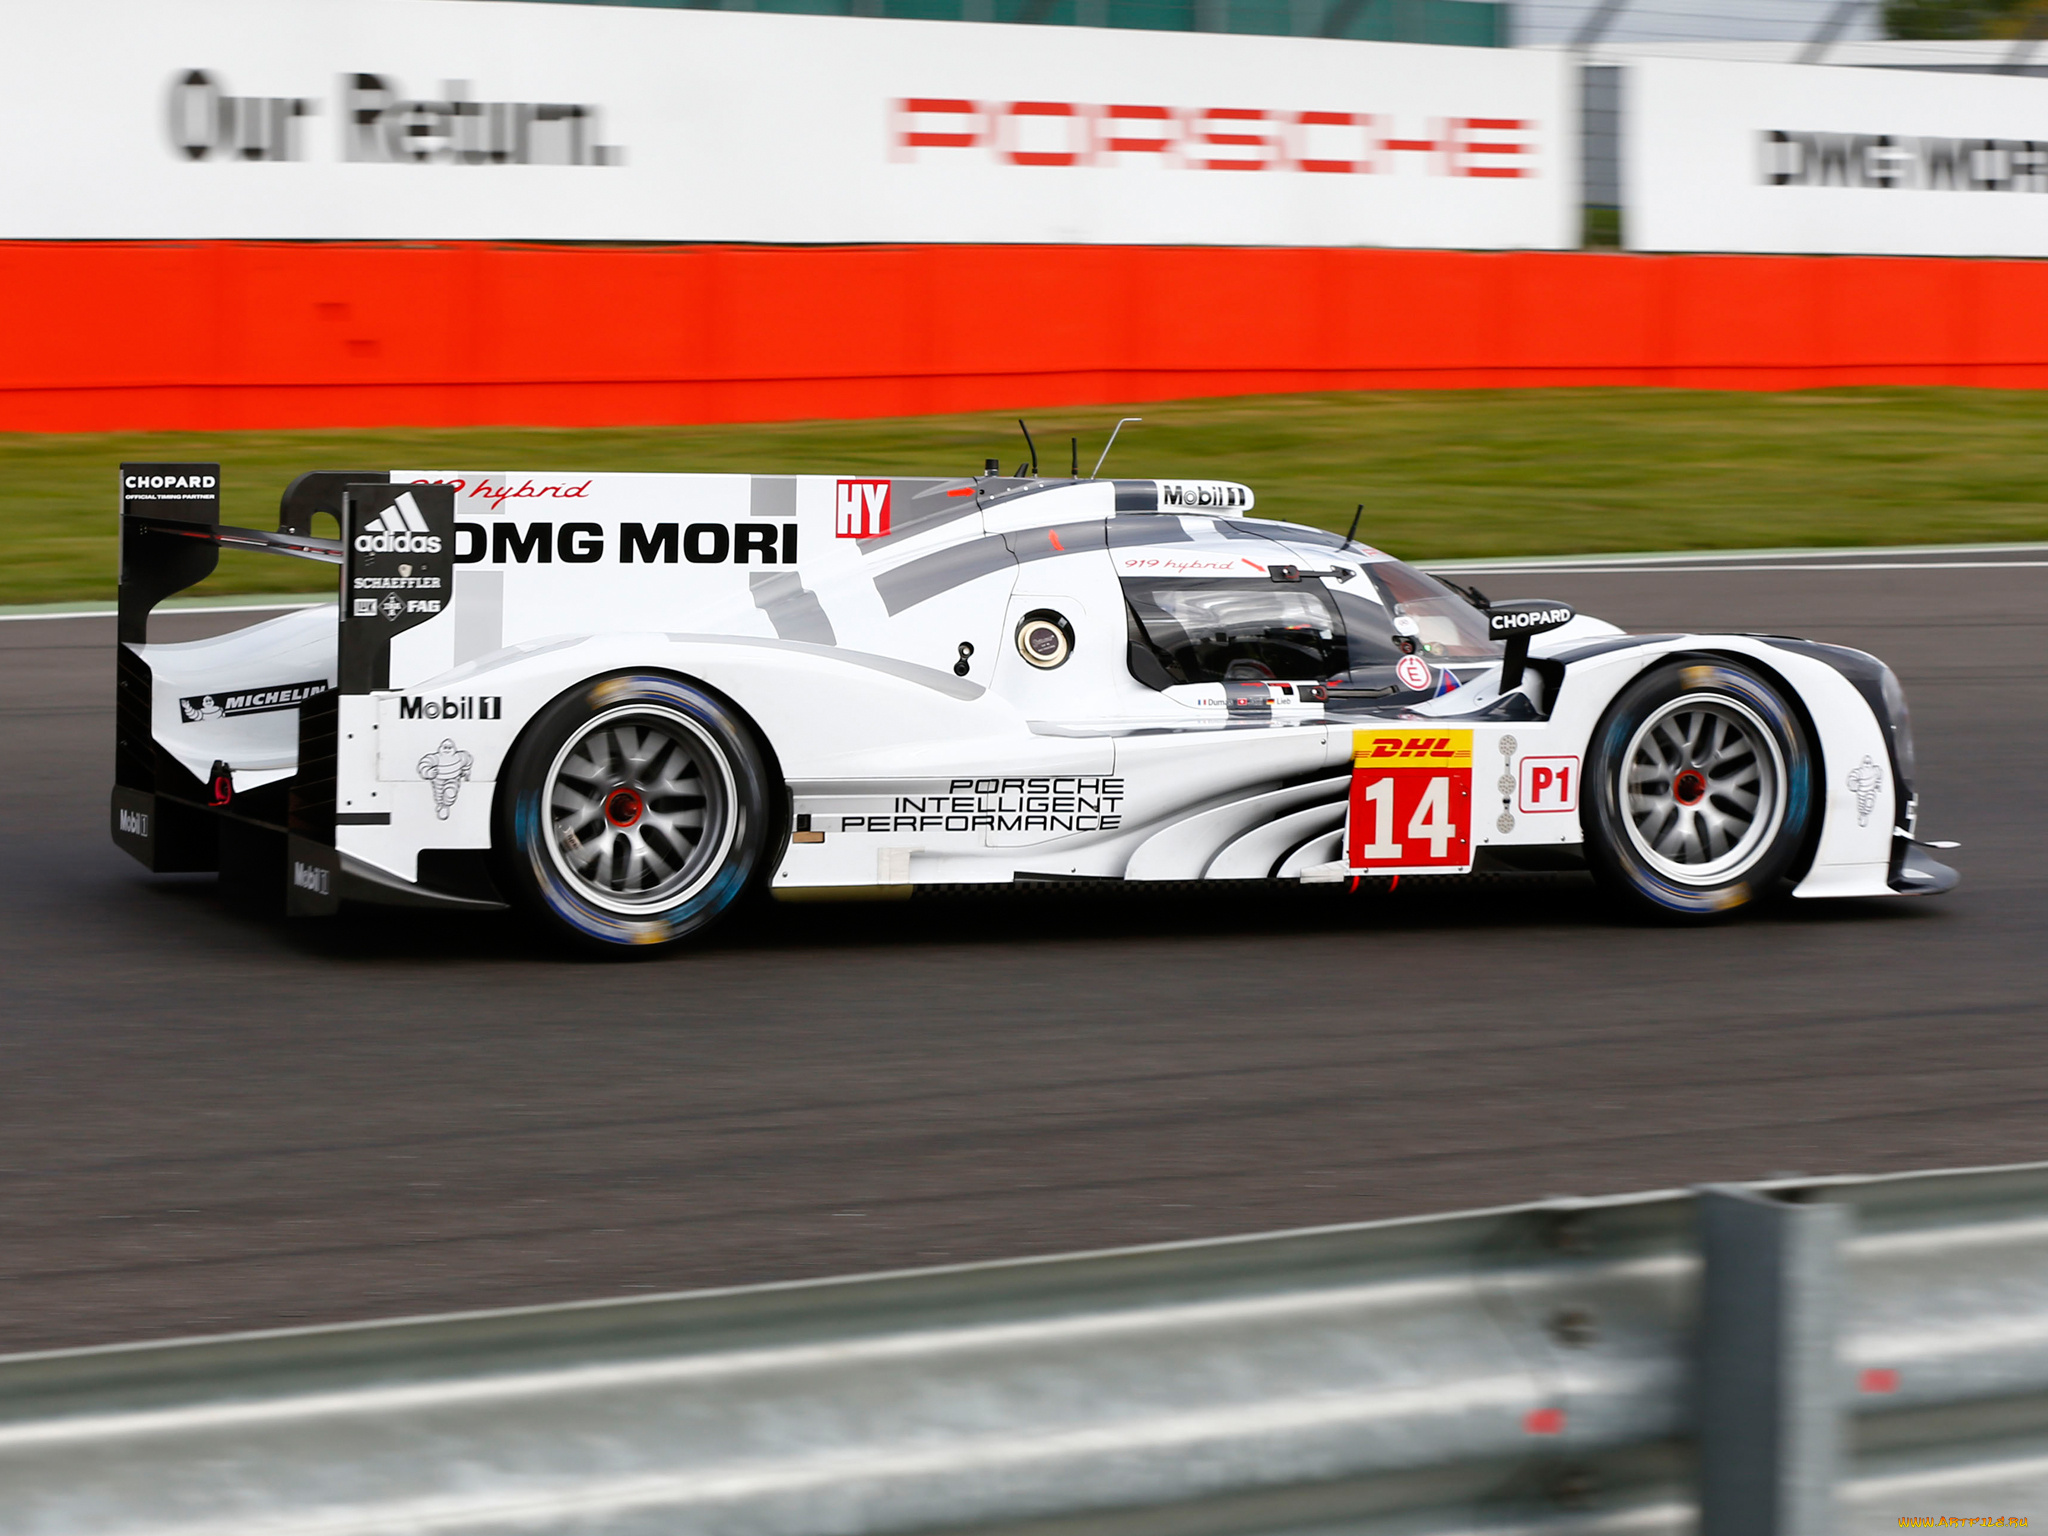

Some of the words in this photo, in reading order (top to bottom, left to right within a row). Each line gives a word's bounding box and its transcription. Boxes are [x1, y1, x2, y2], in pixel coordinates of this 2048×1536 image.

[163, 67, 312, 161] Our
[338, 72, 625, 166] Return.
[890, 97, 1537, 179] PORSCHE
[125, 475, 216, 489] CHOPARD
[468, 479, 593, 510] hybrid
[1164, 485, 1222, 506] Mobil
[1227, 487, 1245, 506] 1
[837, 483, 890, 535] HY
[354, 531, 442, 553] adidas
[454, 522, 604, 564] DMG
[619, 523, 798, 564] MORI
[1125, 559, 1159, 568] 919
[1164, 559, 1234, 573] hybrid
[354, 577, 441, 589] SCHAEFFLER
[407, 600, 441, 612] FAG
[1491, 608, 1571, 629] CHOPARD
[225, 685, 326, 709] MICHELIN
[400, 696, 473, 719] Mobil
[479, 696, 501, 719] 1
[1371, 738, 1454, 757] DHL
[949, 779, 1124, 794] PORSCHE
[1532, 766, 1570, 803] P1
[895, 797, 1124, 813] INTELLIGENT
[120, 809, 140, 835] Mobil
[841, 815, 1122, 832] PERFORMANCE
[1364, 777, 1456, 858] 14
